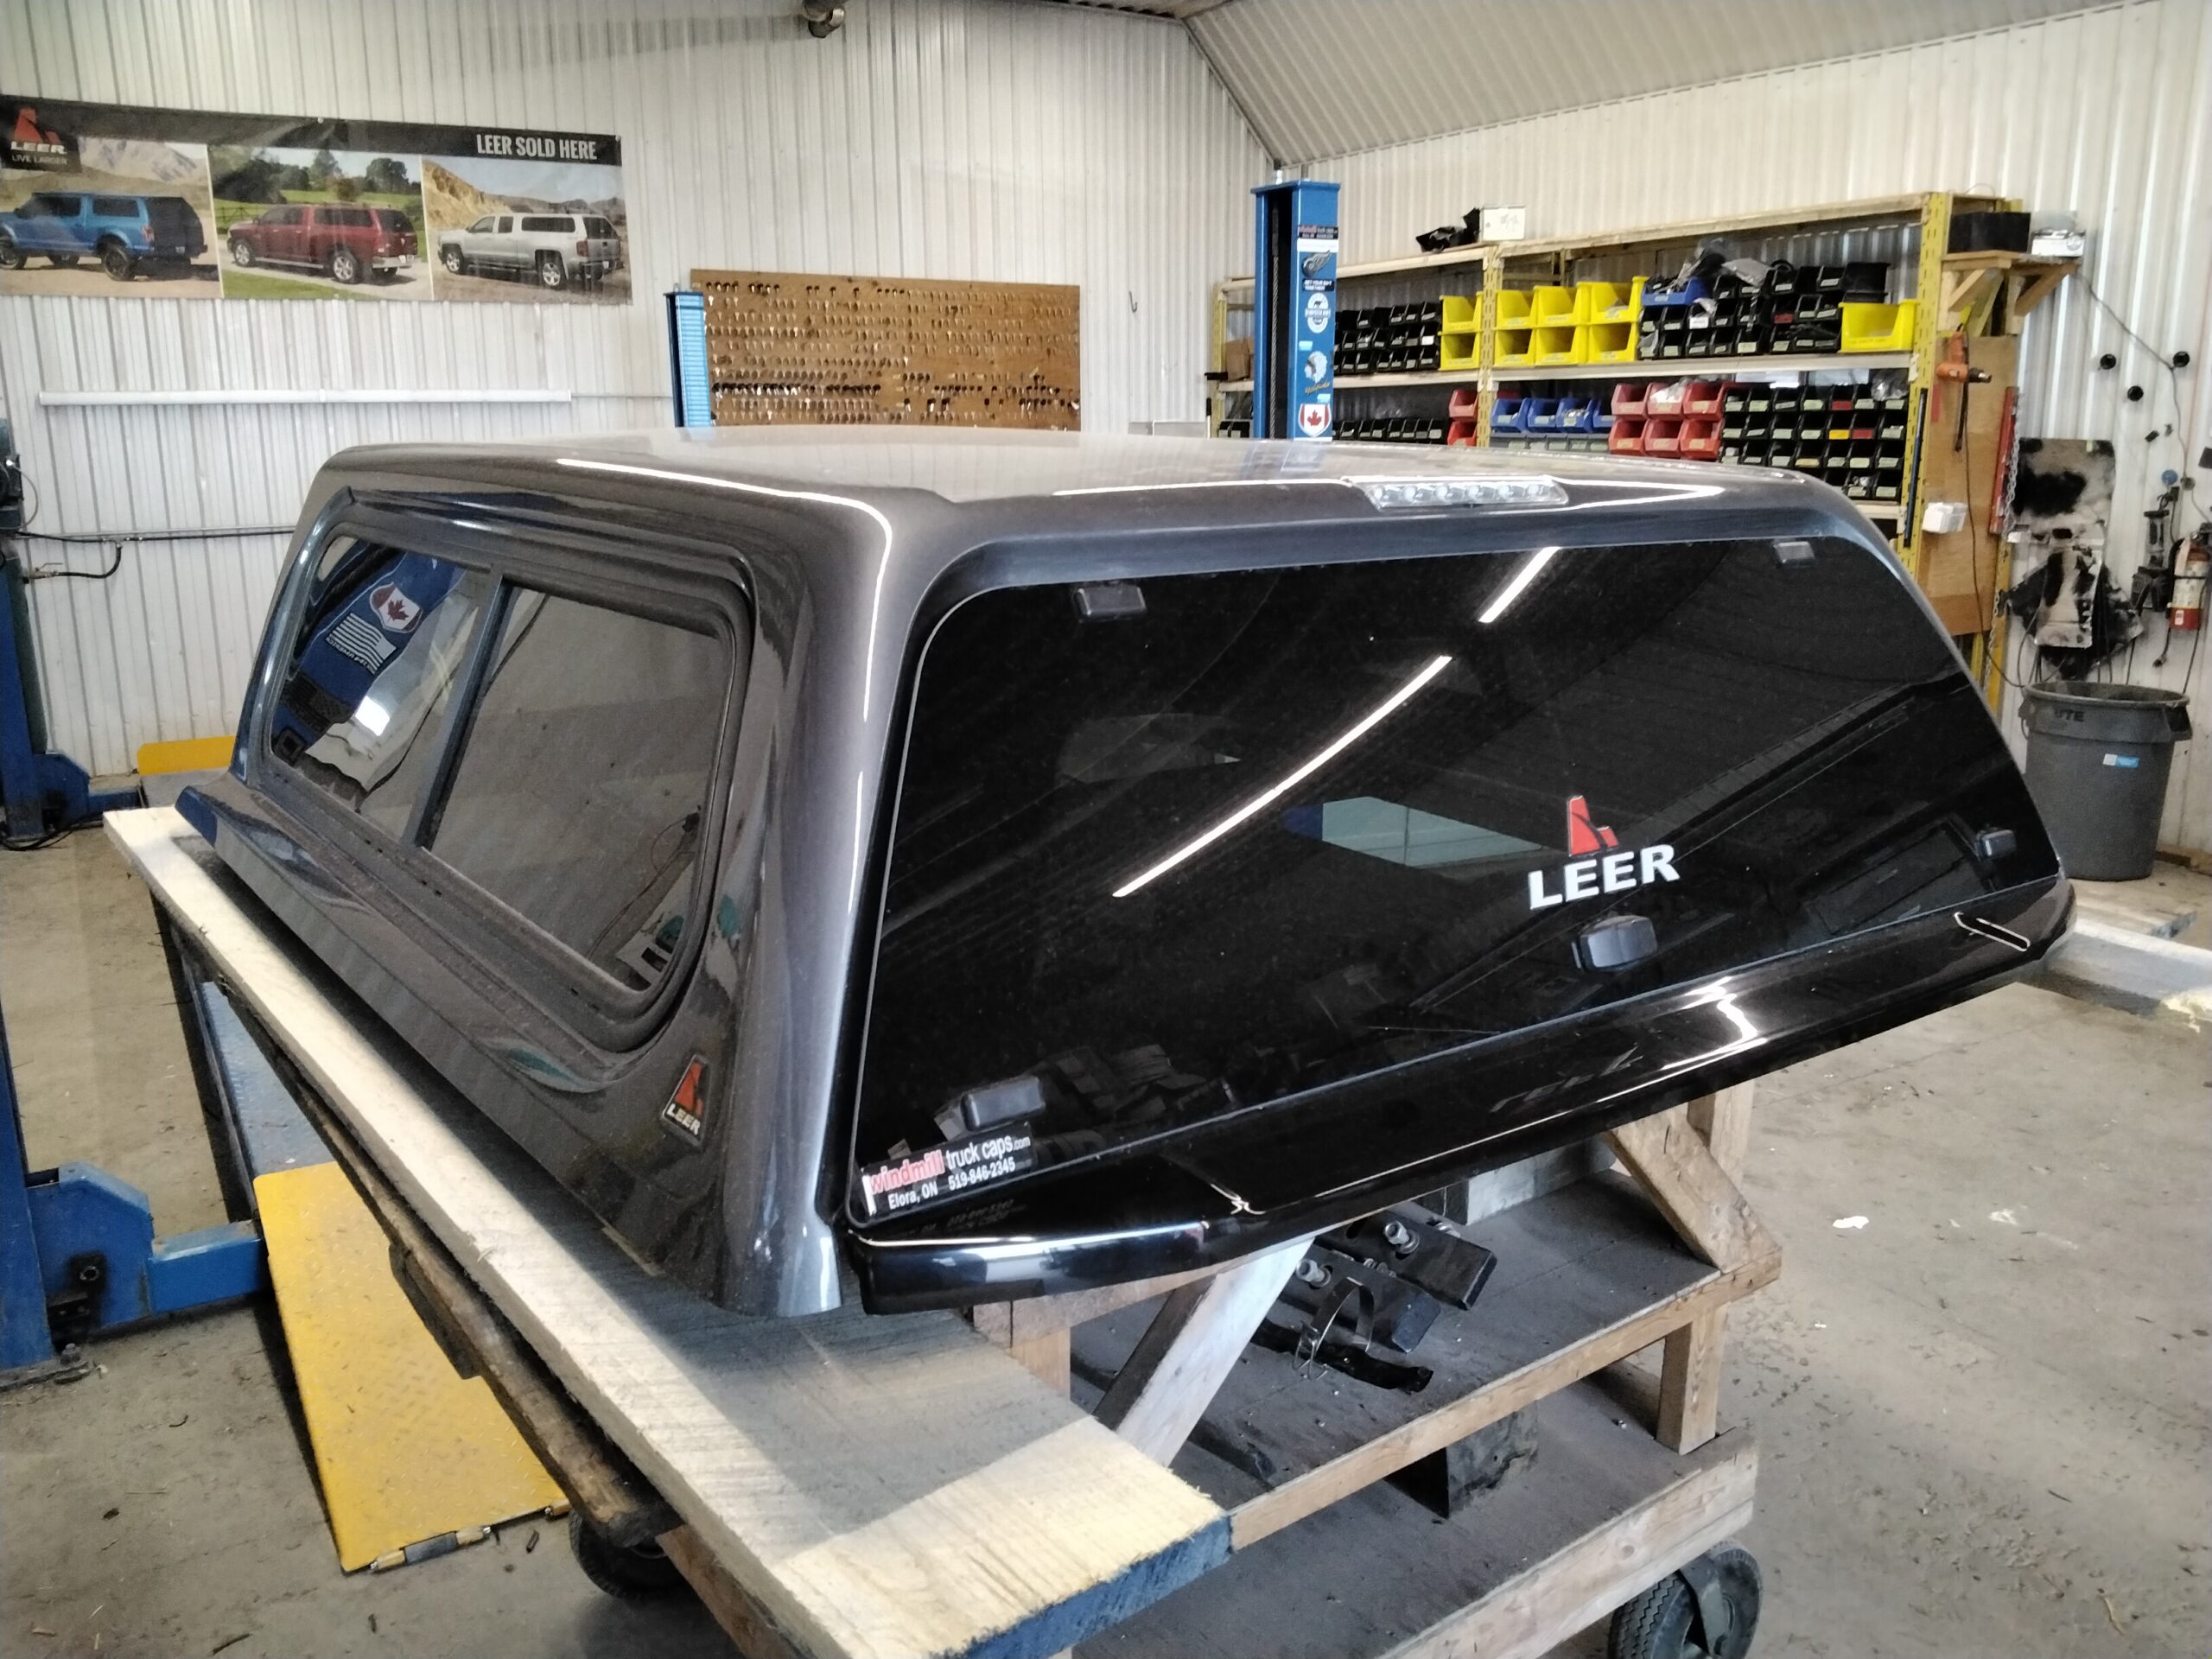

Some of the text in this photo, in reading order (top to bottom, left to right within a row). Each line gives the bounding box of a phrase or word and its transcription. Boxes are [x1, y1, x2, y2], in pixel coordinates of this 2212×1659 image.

[10, 141, 67, 154] LEER
[476, 134, 598, 160] LEER SOLD HERE
[1528, 844, 1681, 910] LEER
[667, 1103, 701, 1135] LEER
[870, 1149, 946, 1195] windmill
[945, 1141, 981, 1170] truck
[888, 1190, 921, 1210] Elora,
[921, 1180, 939, 1198] ON
